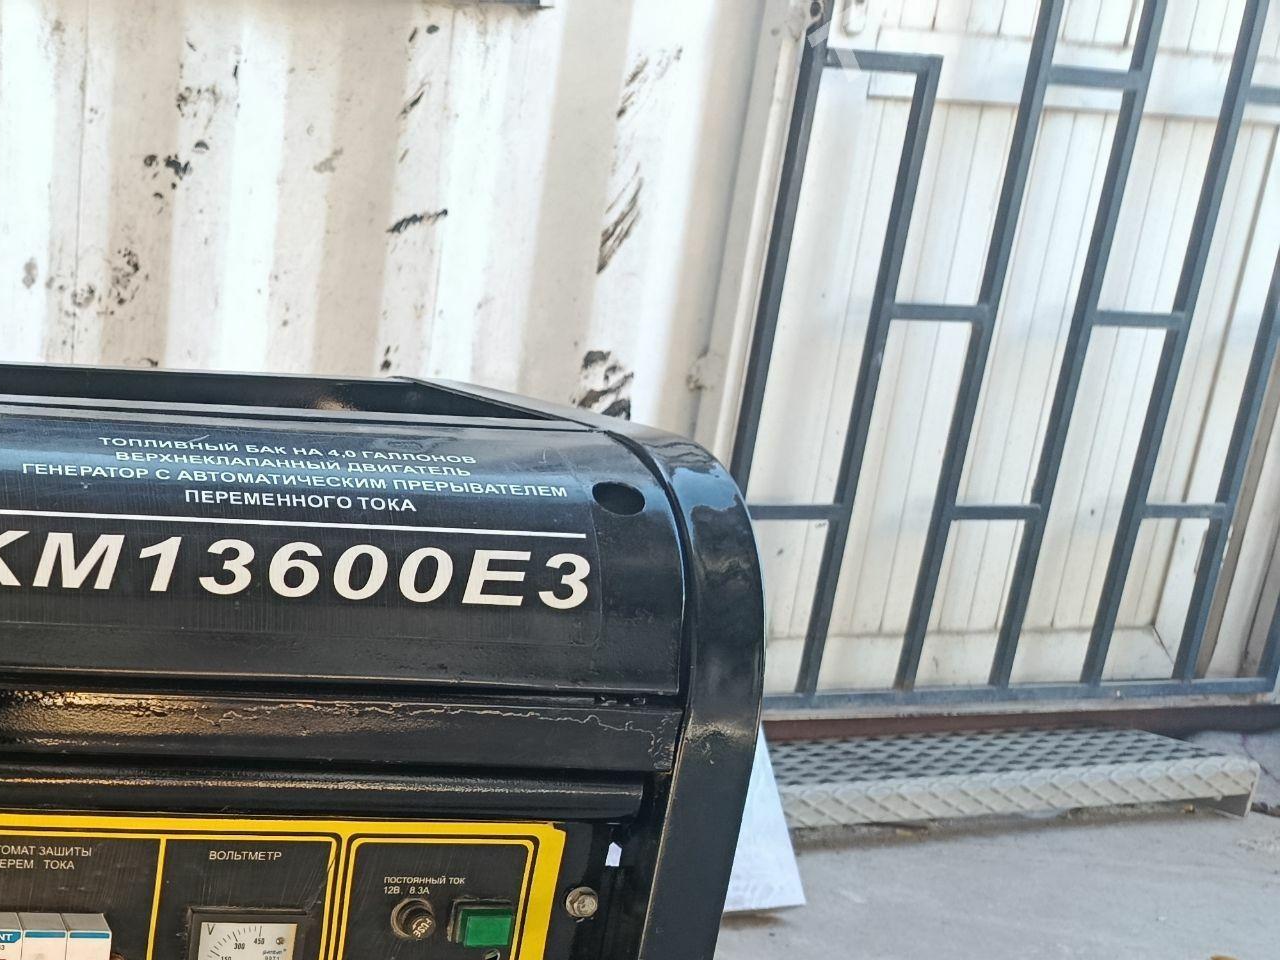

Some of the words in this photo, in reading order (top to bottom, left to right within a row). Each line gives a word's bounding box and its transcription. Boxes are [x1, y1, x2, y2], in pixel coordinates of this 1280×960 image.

[98, 437, 239, 452] ТОПЛИВНЫЙ
[245, 444, 286, 455] БАК
[292, 447, 324, 457] НА
[327, 449, 357, 459] 4,0
[363, 451, 477, 465] ГАЛЛОНОВ
[115, 451, 341, 470] ВЕРХНЕКЛАПАННЫЙ
[347, 463, 471, 477] ДВИГАТЕЛЬ
[22, 463, 149, 480] ГЕНЕРАТОР
[155, 469, 171, 480] С
[176, 470, 386, 490] АВТОМАТИЧЕСКИМ
[392, 479, 568, 498] ПРЕРЫВАТЕЛЕМ
[184, 489, 352, 509] ПЕРЕМЕННОГО
[357, 496, 417, 513] ТОКА
[208, 850, 283, 861] ВОЛЬТМЕТР
[43, 859, 75, 870] ТОКА
[383, 875, 447, 885] ПОСТОЯННЫЙ
[448, 876, 466, 885] ТОК
[206, 924, 216, 936] V
[413, 917, 433, 938] FUSE
[233, 942, 245, 950] 300
[253, 937, 265, 945] 450
